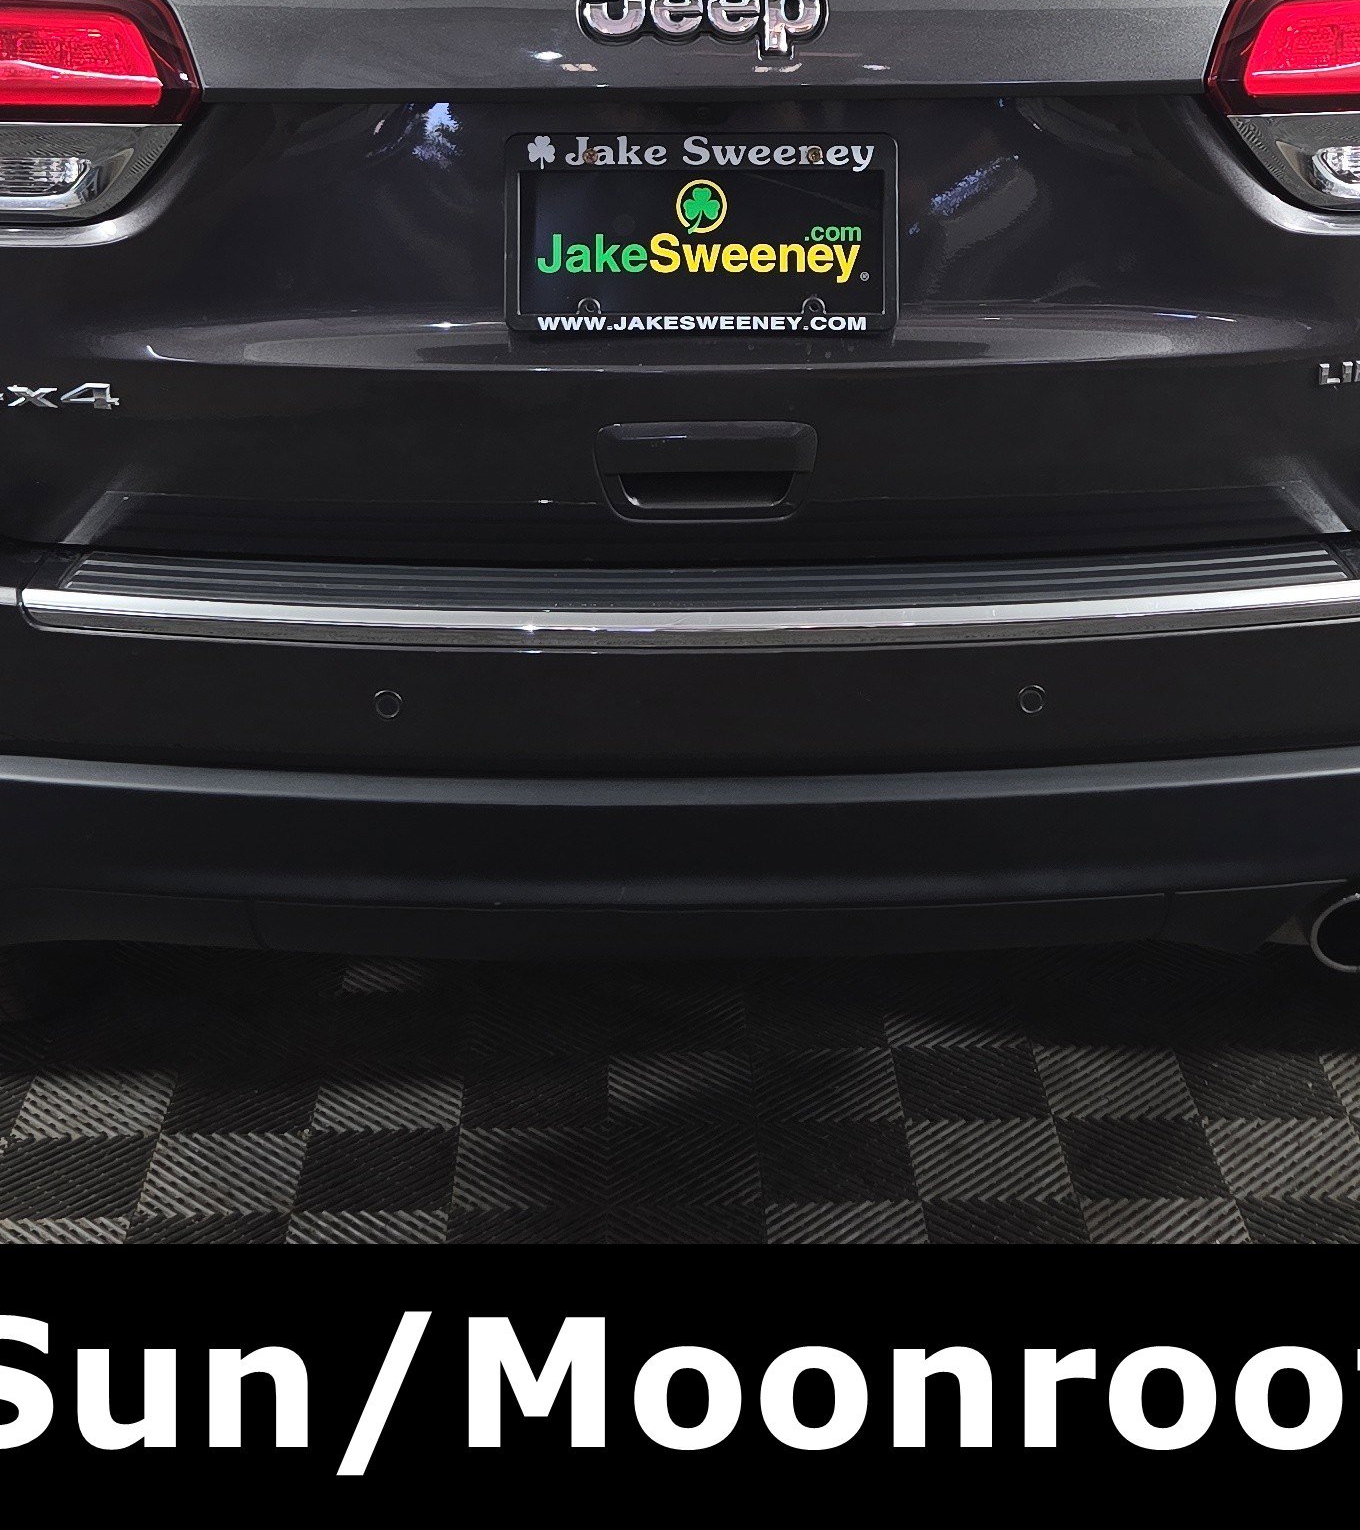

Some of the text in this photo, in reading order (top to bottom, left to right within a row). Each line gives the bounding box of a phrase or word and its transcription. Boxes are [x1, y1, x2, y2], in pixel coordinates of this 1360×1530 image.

[564, 135, 668, 167] Jake
[537, 232, 861, 284] JakeSweeney
[537, 315, 868, 332] WWW.JAKESWEENEY.COM
